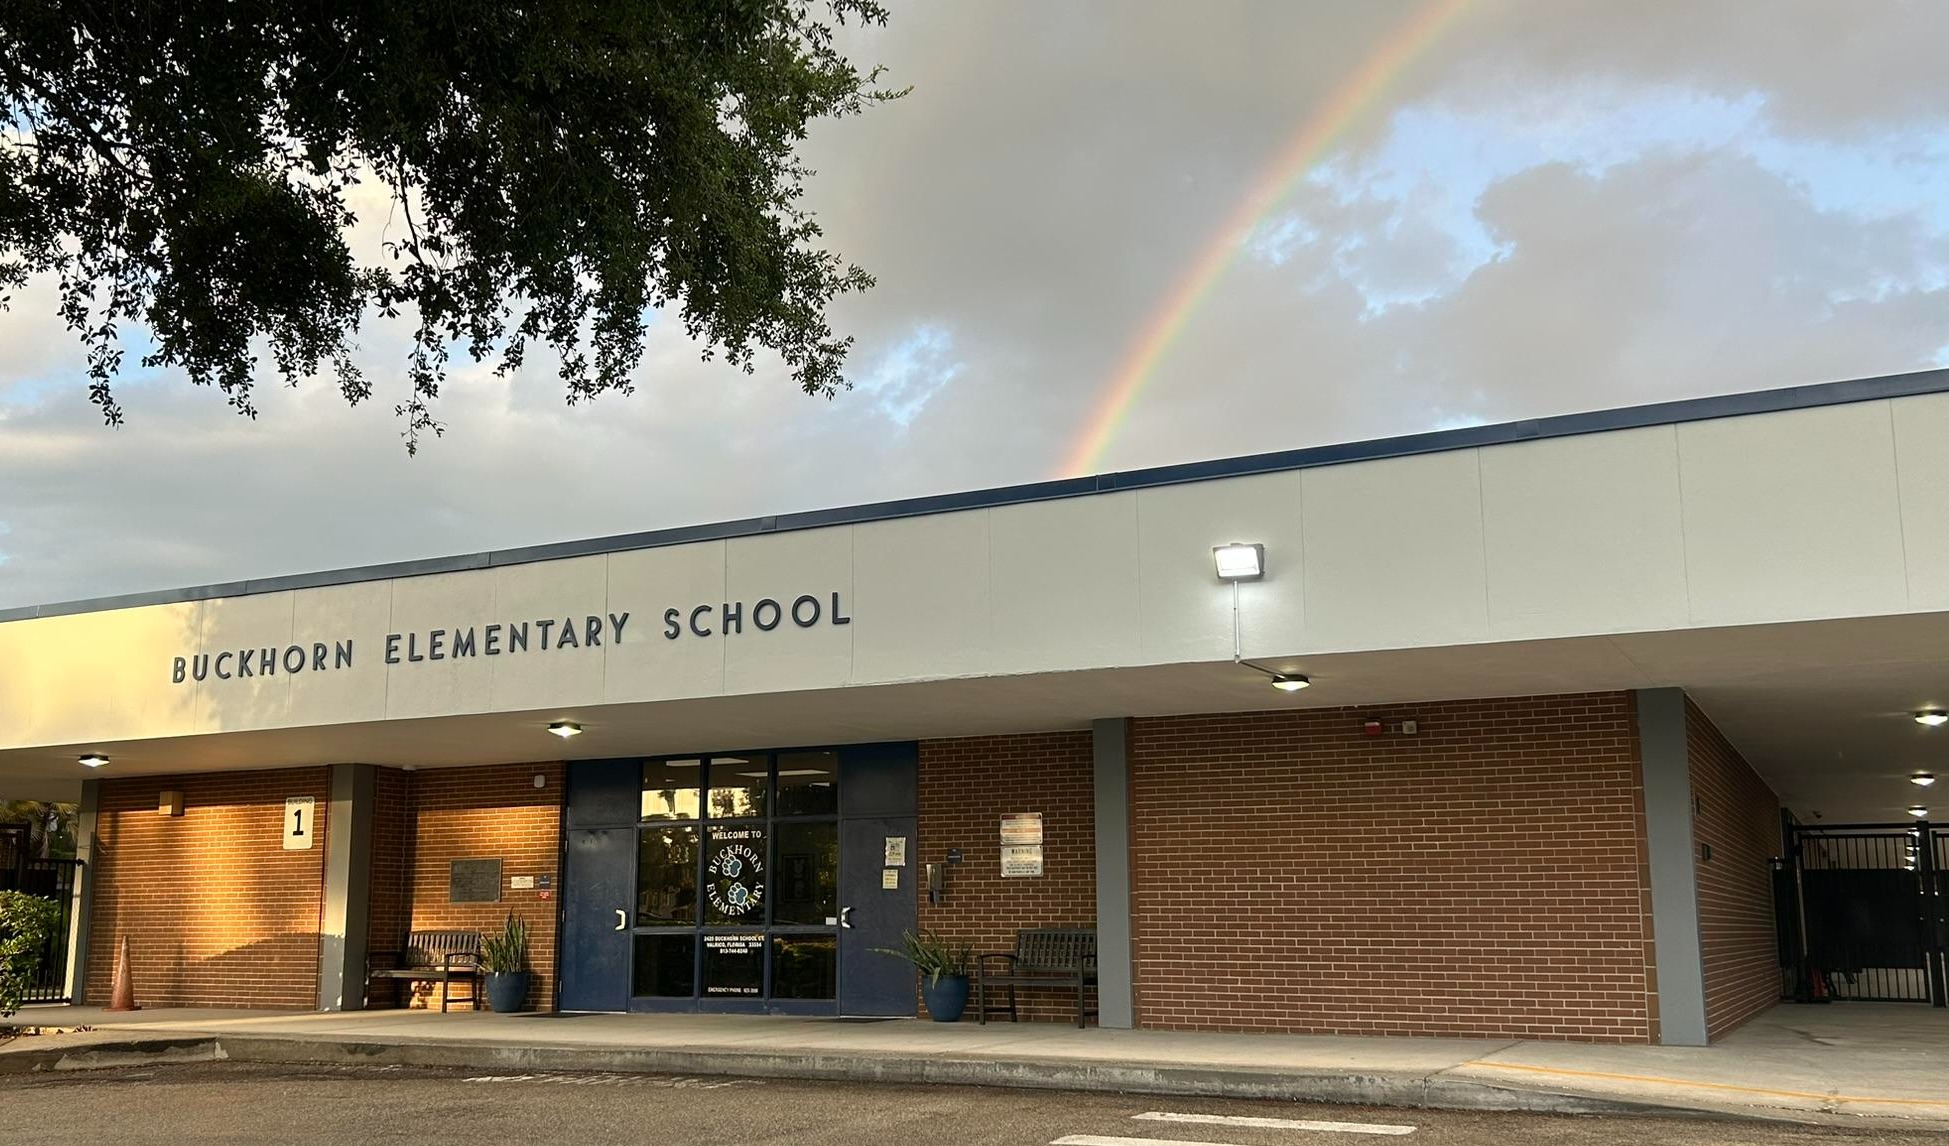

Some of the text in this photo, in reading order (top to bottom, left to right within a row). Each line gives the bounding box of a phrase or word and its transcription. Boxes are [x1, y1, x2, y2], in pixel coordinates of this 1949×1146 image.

[172, 591, 852, 685] BUCKHORN ELEMENTARY SCHOOL
[287, 797, 313, 805] BUILDING
[292, 809, 304, 836] 1
[711, 830, 762, 840] WELCOME TO
[708, 844, 764, 874] BUCKHORN
[706, 881, 765, 916] ELEMENTARY
